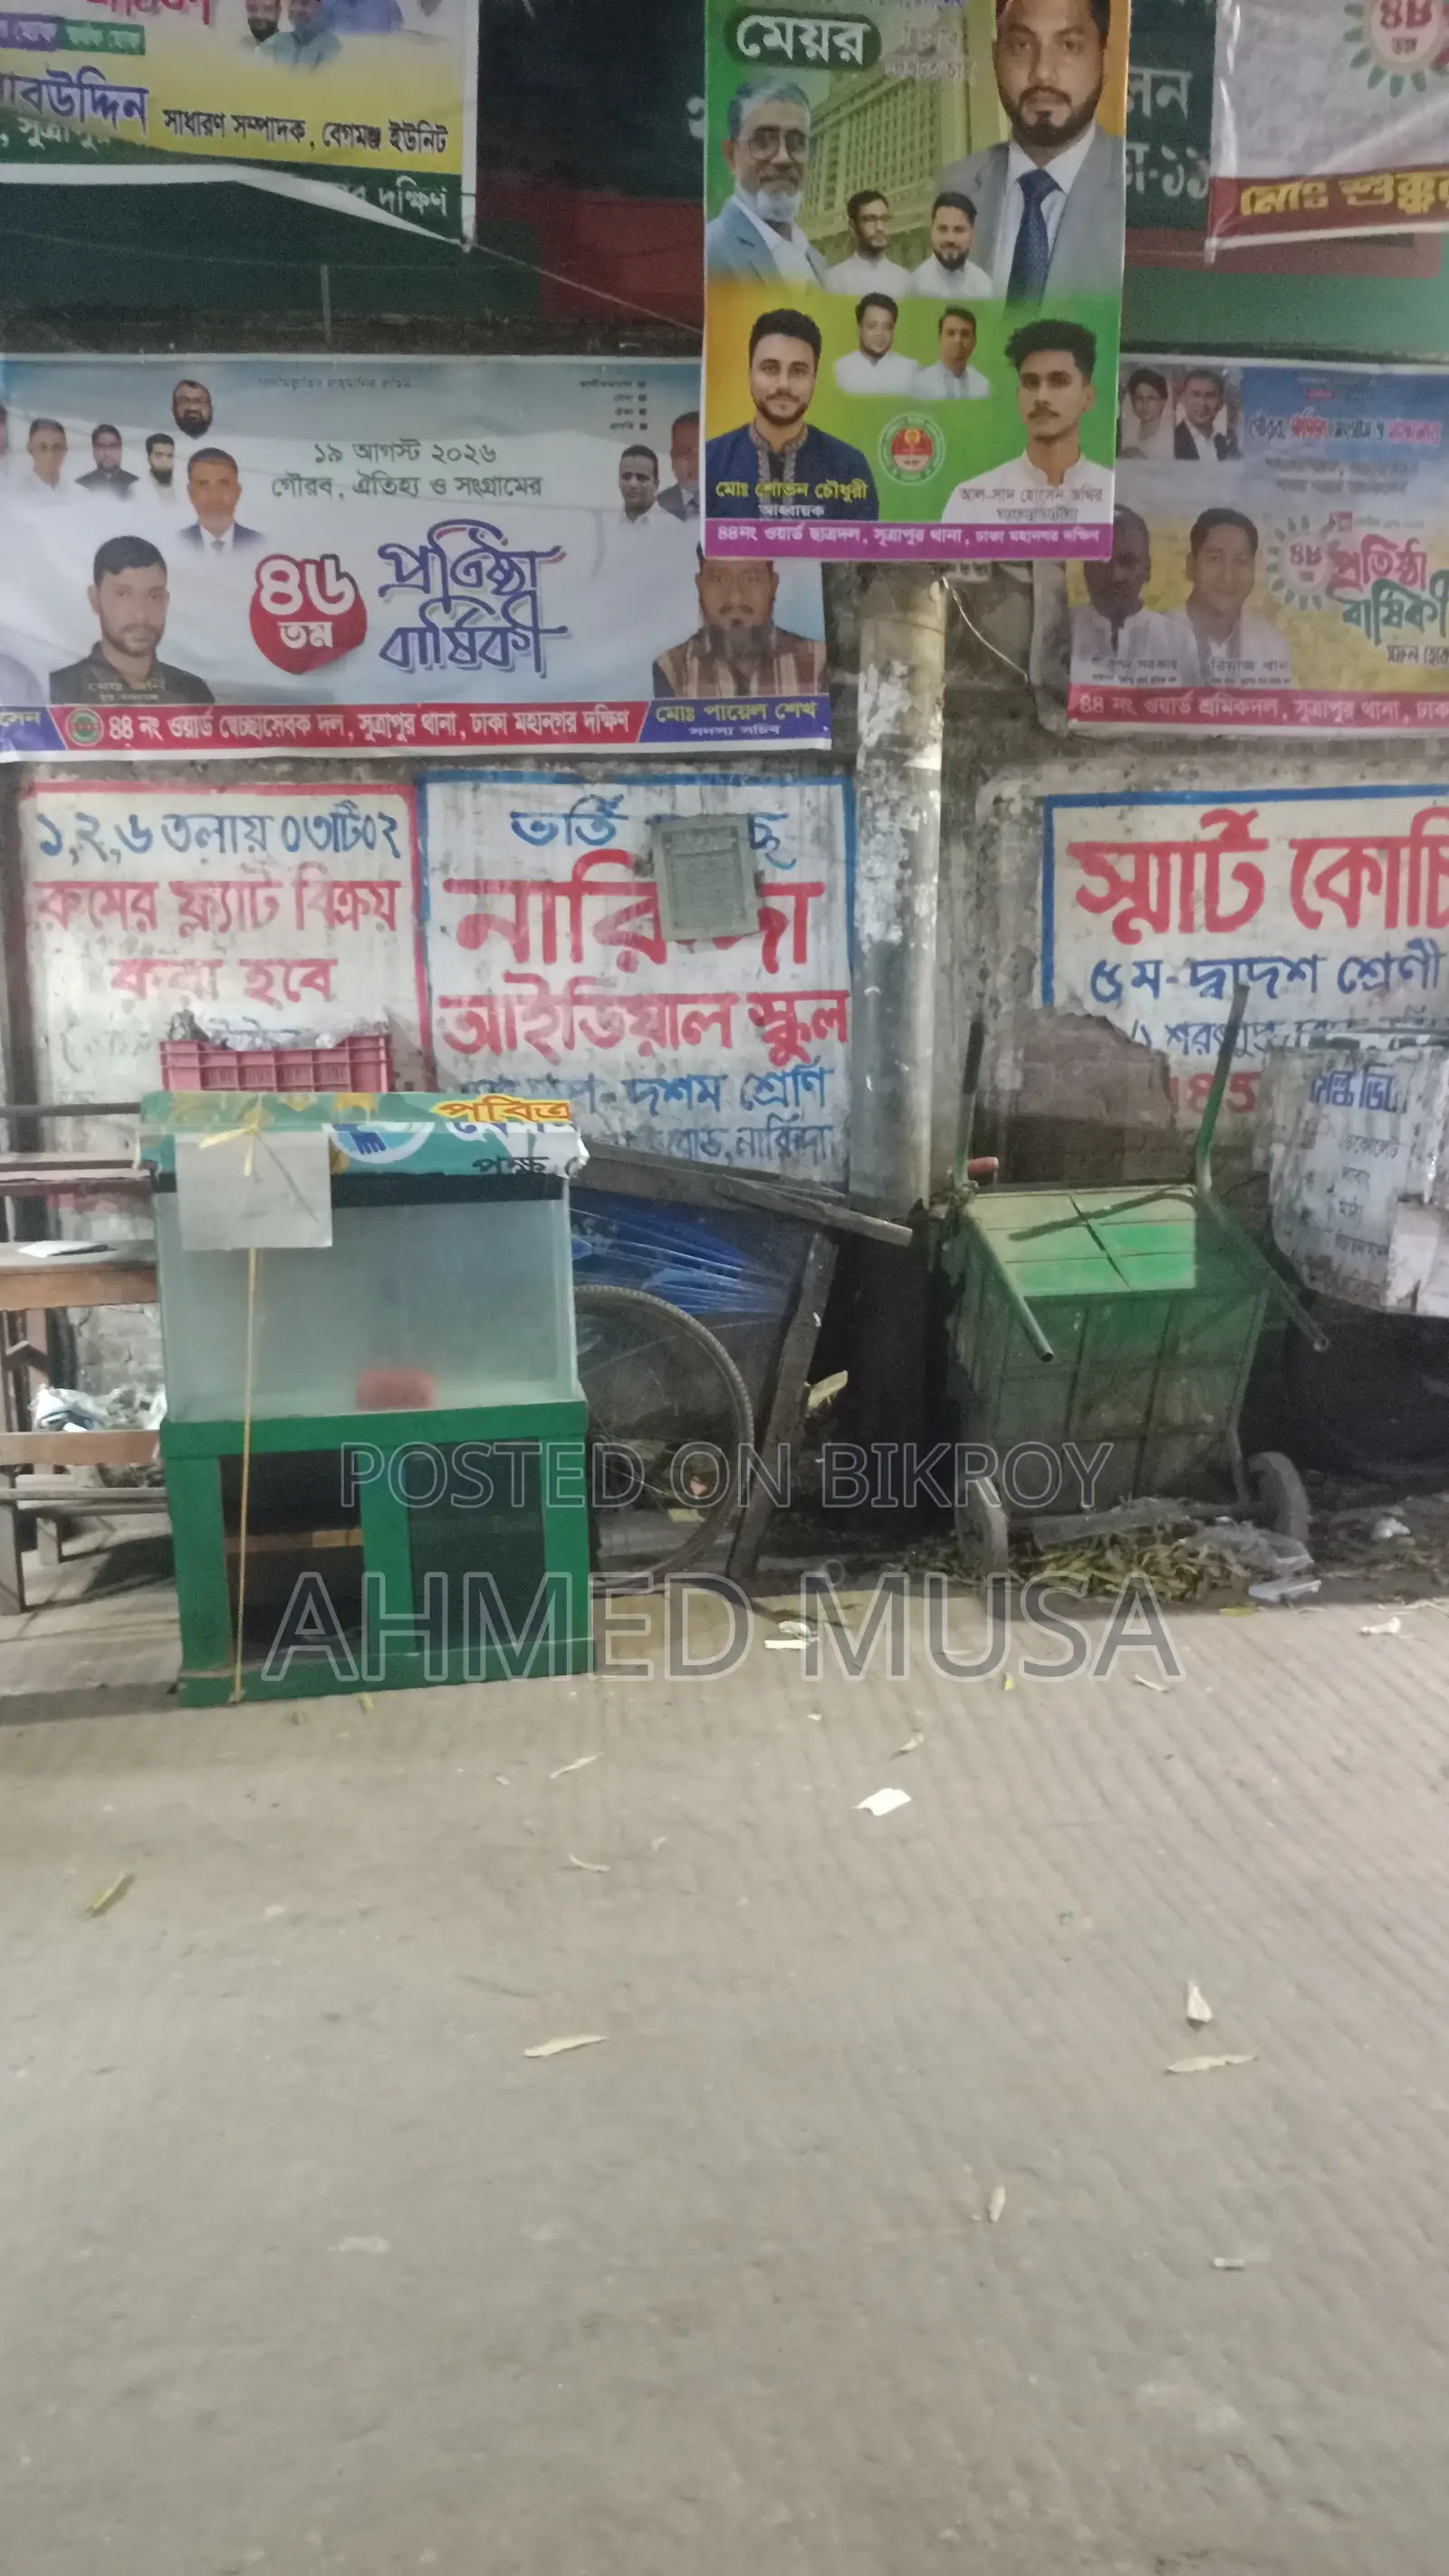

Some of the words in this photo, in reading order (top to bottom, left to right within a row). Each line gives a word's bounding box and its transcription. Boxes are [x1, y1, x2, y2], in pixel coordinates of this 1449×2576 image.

[736, 14, 871, 65] মেয়র
[0, 65, 149, 137] াবউদ্দিন
[162, 109, 226, 139] সাধারণ
[388, 117, 449, 154] ইউনিট
[378, 175, 449, 218] দক্ষিণ
[314, 443, 344, 464] ১৯
[351, 437, 423, 464] আগস্ট
[431, 443, 497, 464] ২০২৬
[351, 468, 421, 498] ঐতিহ্য
[429, 477, 448, 496] ও
[454, 474, 544, 498] সংগ্রামের
[814, 478, 868, 503] চৌধুরী
[763, 521, 806, 541] ওয়ার্ড
[278, 621, 333, 649] তম
[168, 706, 215, 740] ওয়ার্ড
[469, 711, 509, 737] ঢাকা
[513, 710, 578, 736] মহানগর
[656, 705, 696, 723] মোঃ
[1416, 700, 1449, 721] ঢাক
[162, 812, 274, 854] তলায়
[508, 793, 629, 847] ভর্তি
[295, 860, 401, 933] বিক্রয়
[1067, 808, 1269, 945] স্মার্ট
[238, 958, 339, 1010] হবে
[436, 971, 741, 1066] আইডিয়াল
[744, 988, 851, 1068] স্কুল
[437, 1095, 571, 1122] পবিত্র
